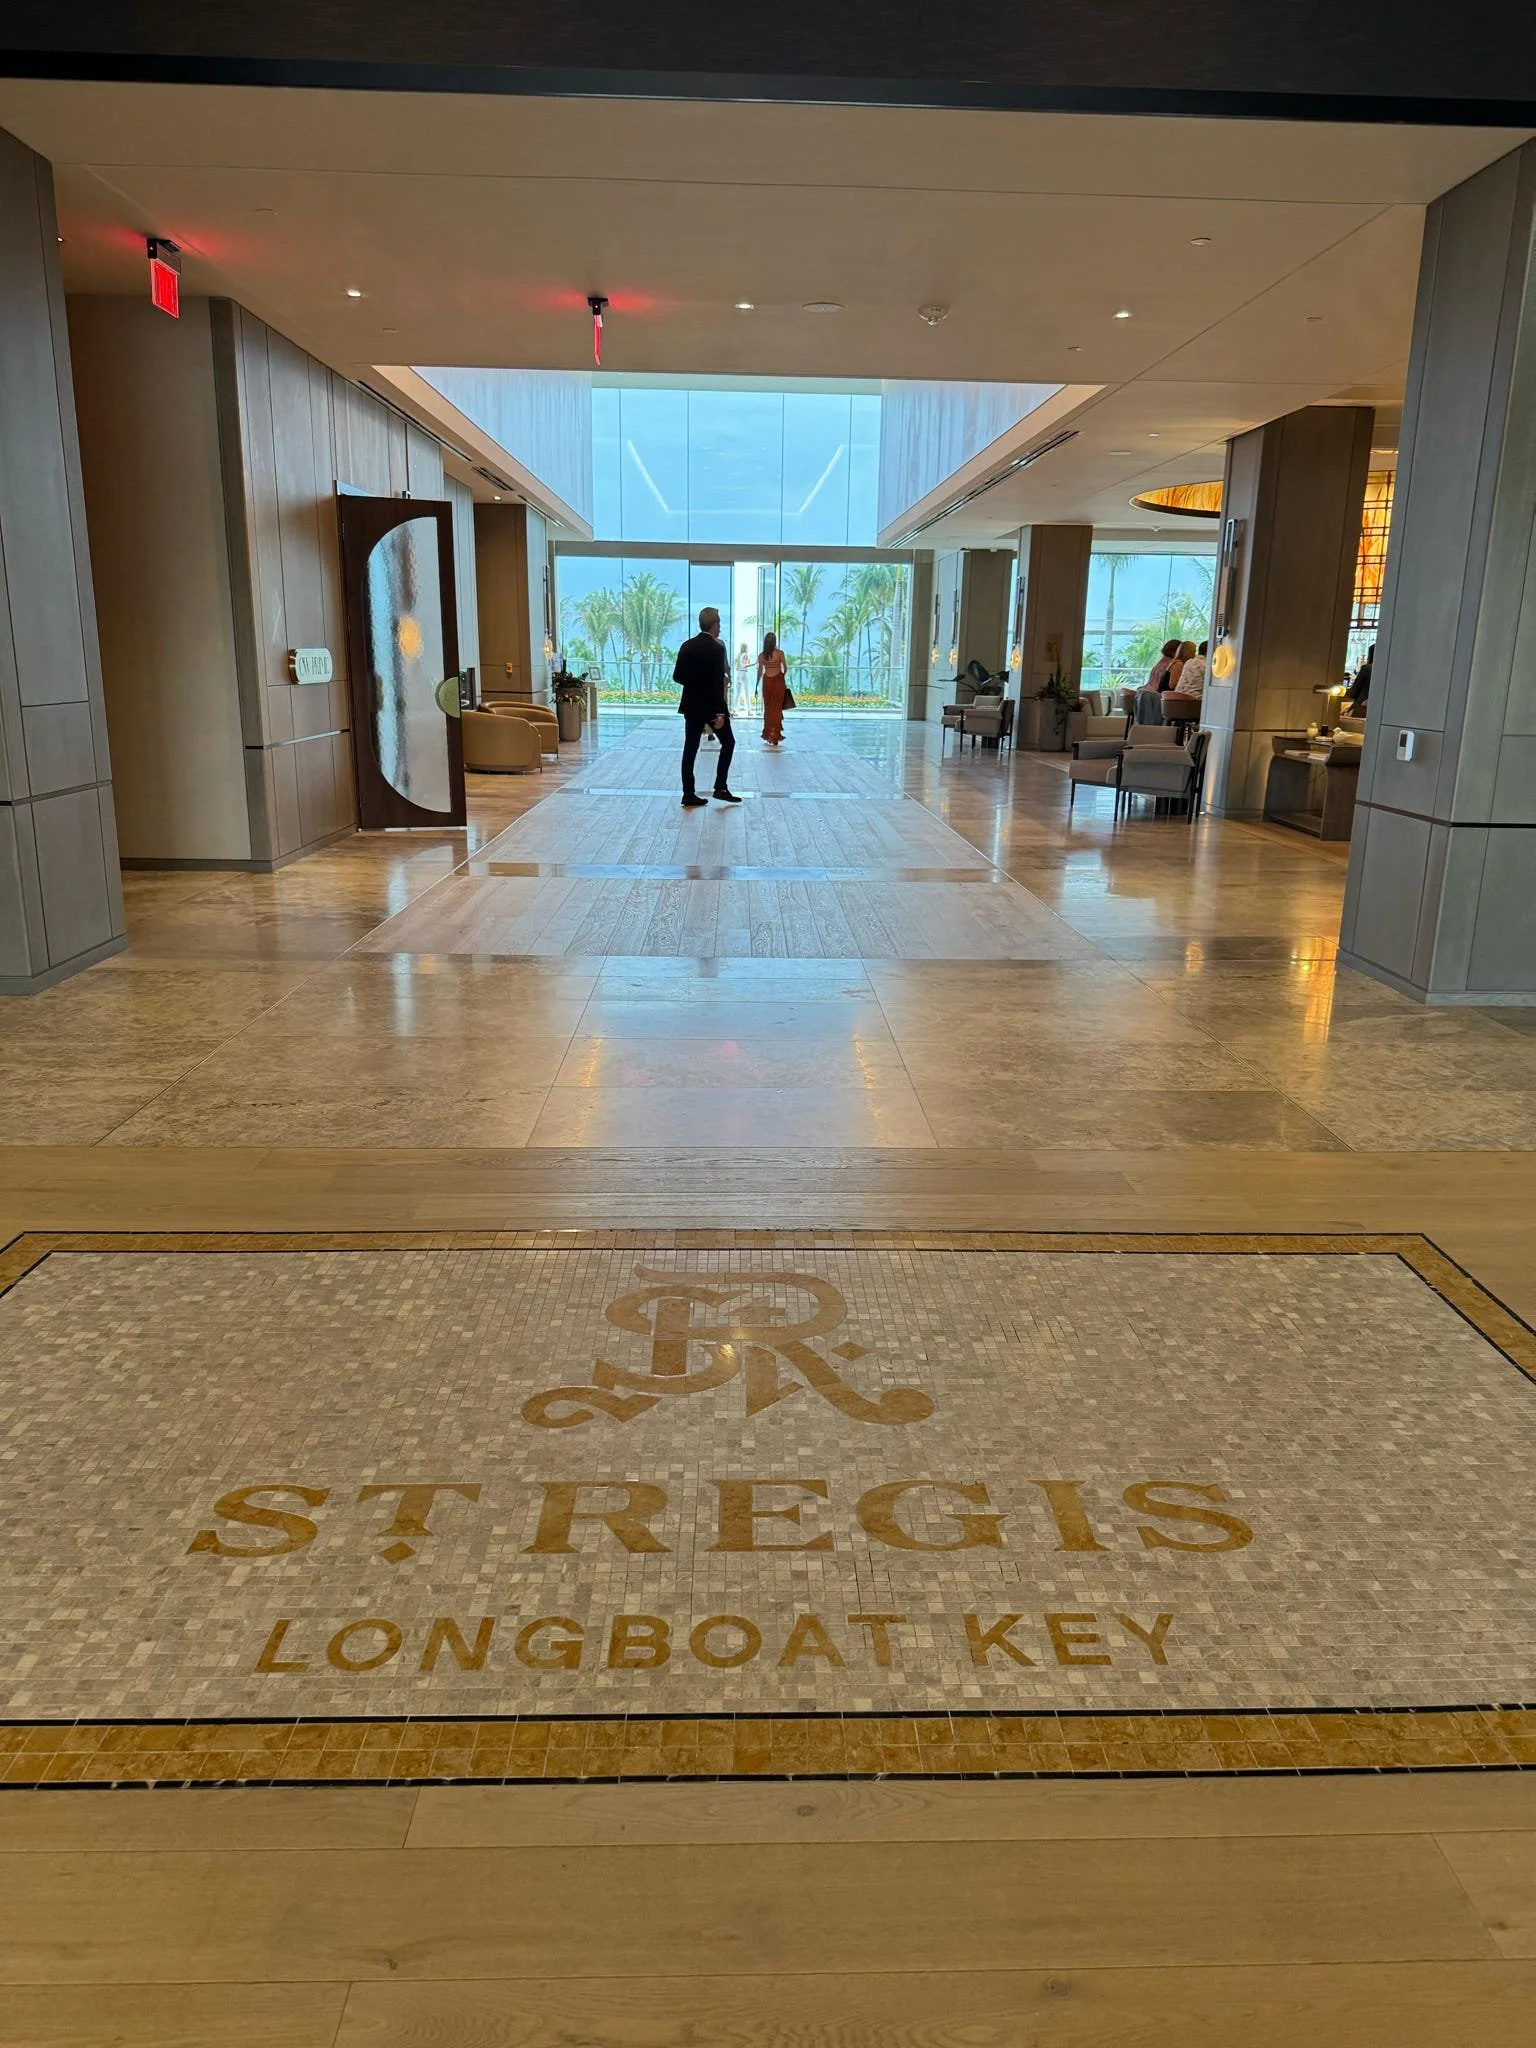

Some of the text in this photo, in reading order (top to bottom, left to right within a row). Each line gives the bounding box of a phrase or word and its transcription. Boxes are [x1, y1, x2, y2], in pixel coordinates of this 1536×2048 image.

[520, 1479, 1255, 1555] REGIS
[254, 1612, 1175, 1674] LONGBOAT KEY
